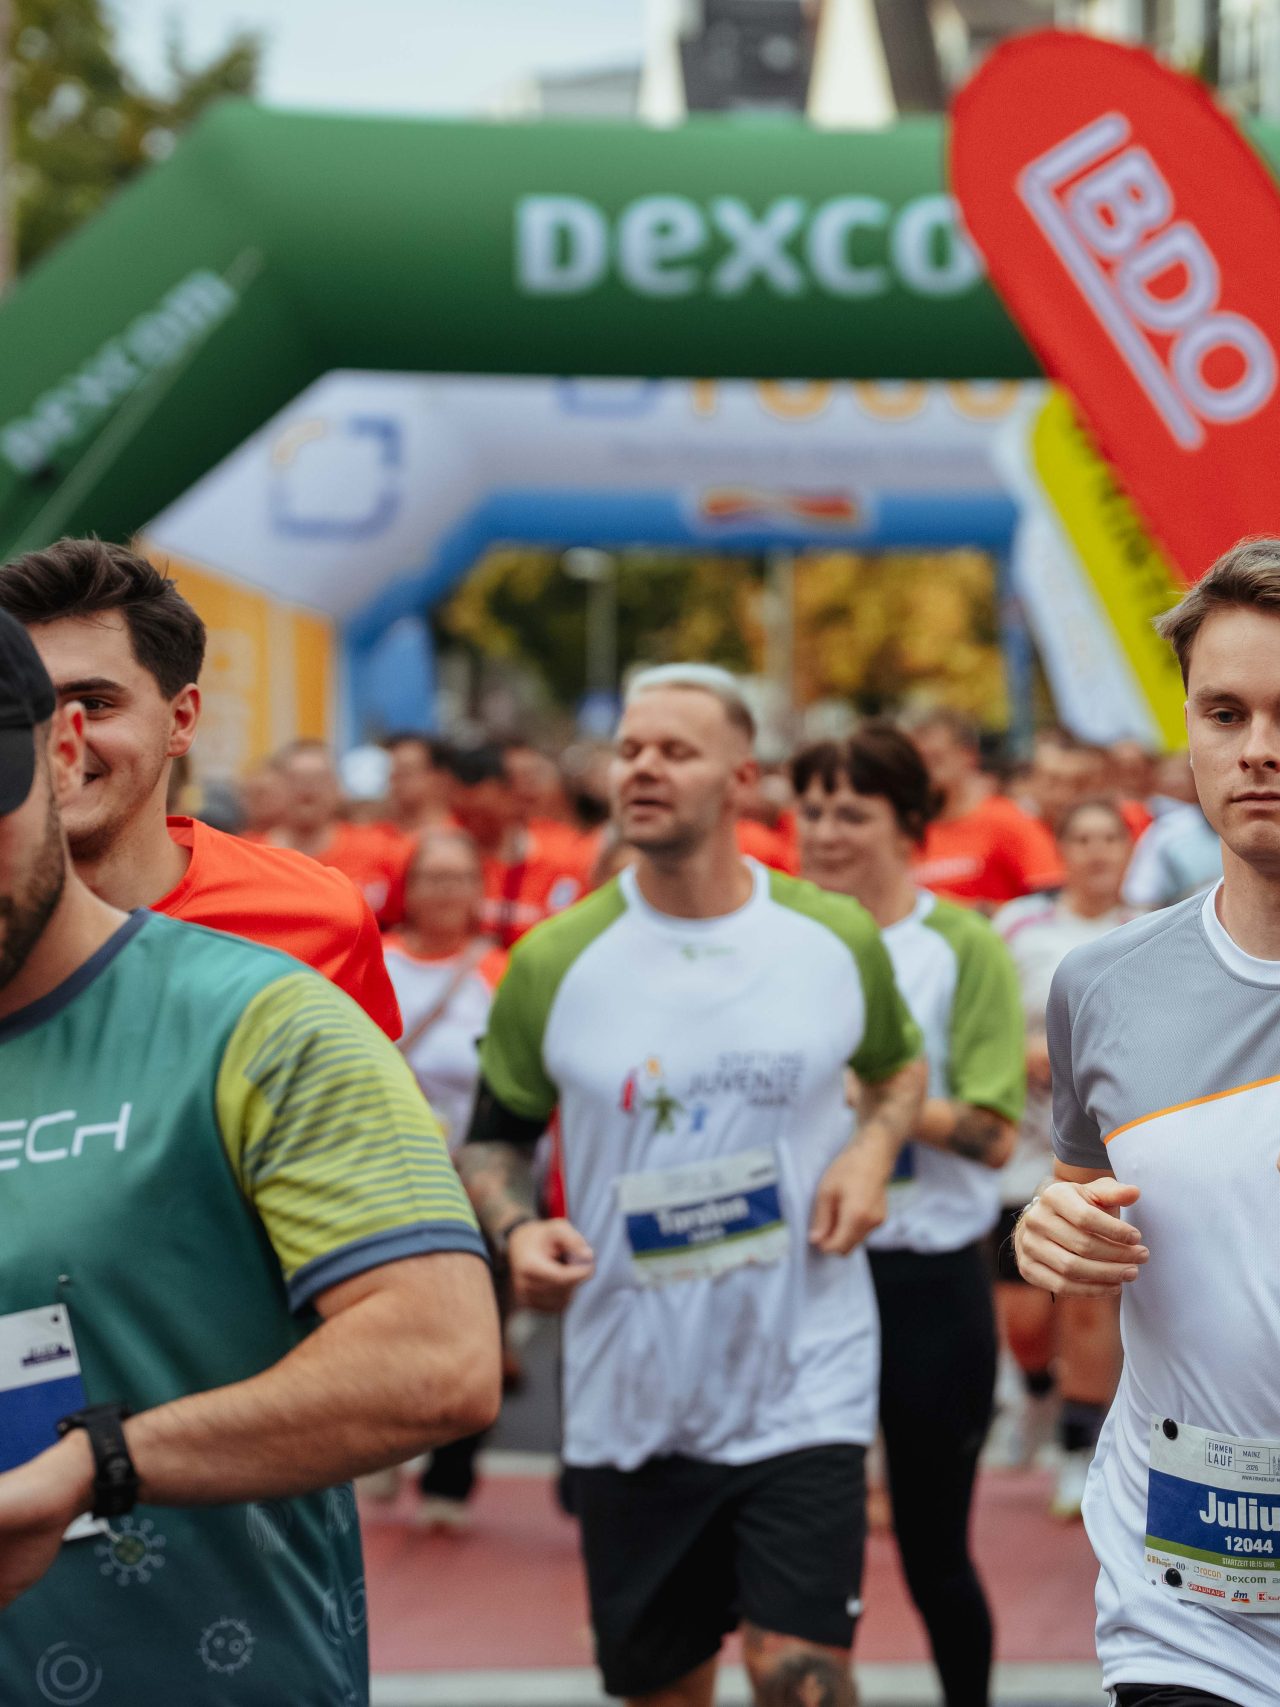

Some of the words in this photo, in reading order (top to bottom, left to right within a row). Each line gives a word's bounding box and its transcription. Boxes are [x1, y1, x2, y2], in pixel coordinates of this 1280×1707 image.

[515, 193, 988, 298] Dexco
[1062, 146, 1278, 424] BDO
[1208, 1442, 1233, 1454] FIRMEN
[1242, 1450, 1261, 1458] MAINZ
[1208, 1452, 1232, 1467] LAUF
[1224, 1535, 1274, 1554] 12044
[1222, 1557, 1248, 1567] STARTZEIT
[1233, 1590, 1248, 1599] dm
